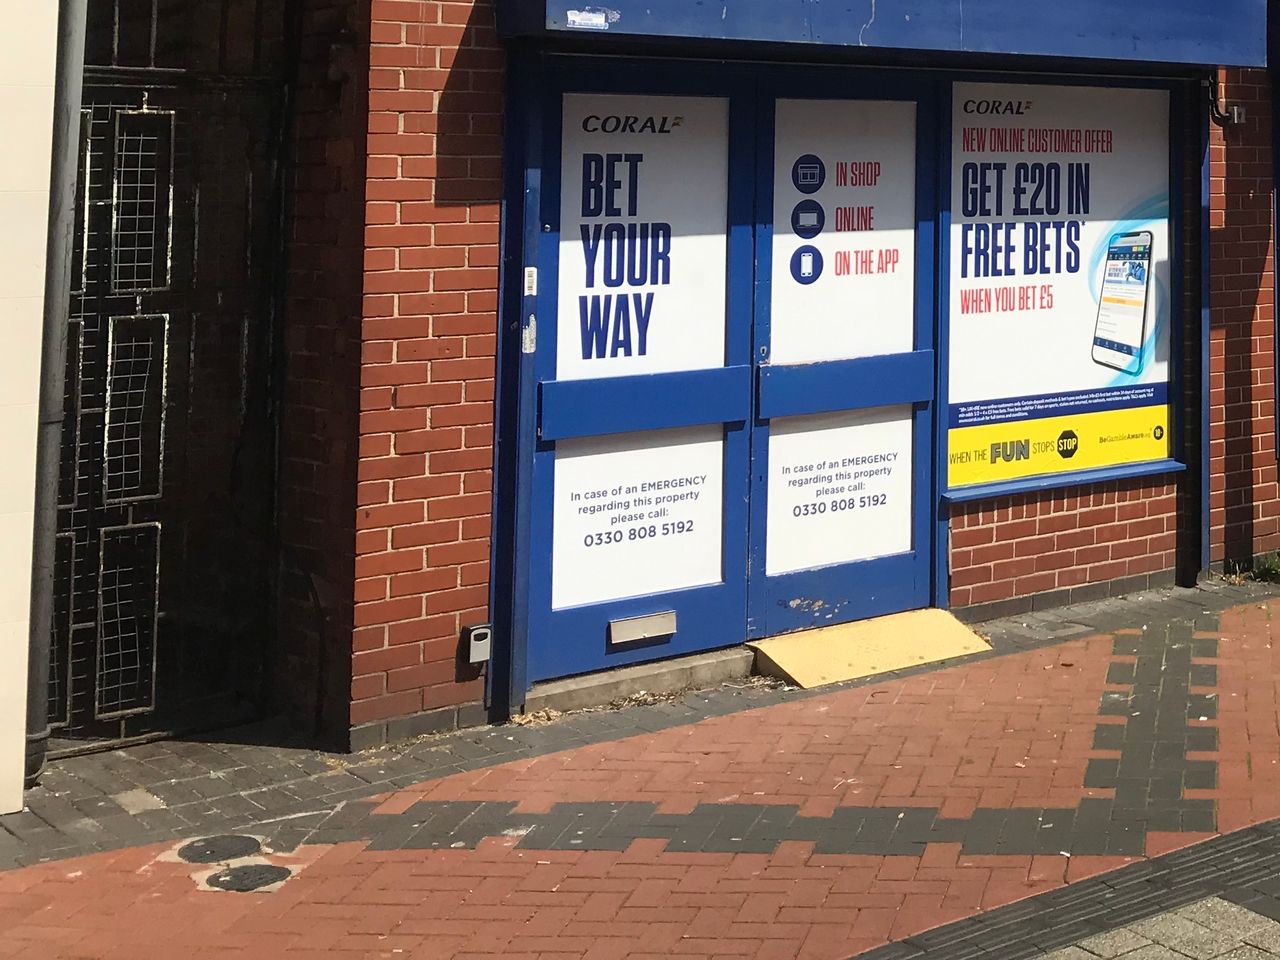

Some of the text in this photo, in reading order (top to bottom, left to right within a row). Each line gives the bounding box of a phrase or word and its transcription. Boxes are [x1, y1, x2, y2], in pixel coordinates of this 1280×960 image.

[963, 99, 1025, 116] CORAL
[582, 115, 672, 134] CORAL
[962, 127, 1113, 153] NEW ONLINE CUSTOMER OFFER
[581, 153, 643, 218] BET
[835, 162, 881, 187] IN SHOP
[961, 162, 1090, 218] GET £20 IN
[835, 206, 874, 232] ONLINE
[580, 222, 672, 289] YOUR
[834, 248, 899, 276] ON THE APP
[960, 221, 1017, 279] FREE
[960, 285, 1053, 315] WHEN YOU BET £5
[578, 292, 654, 360] WAY
[782, 452, 898, 474] In case of an EMERGENCY
[949, 437, 1077, 465] WHEN THE FUN STOPS STOP
[570, 475, 707, 501] In case of an EMERGENCY
[788, 466, 892, 487] regarding this property
[578, 491, 700, 515] regarding this property
[816, 482, 866, 498] please call:
[610, 507, 669, 525] please call:
[793, 493, 887, 517] 0330 808 5192
[583, 519, 694, 547] 0330 808 5192
